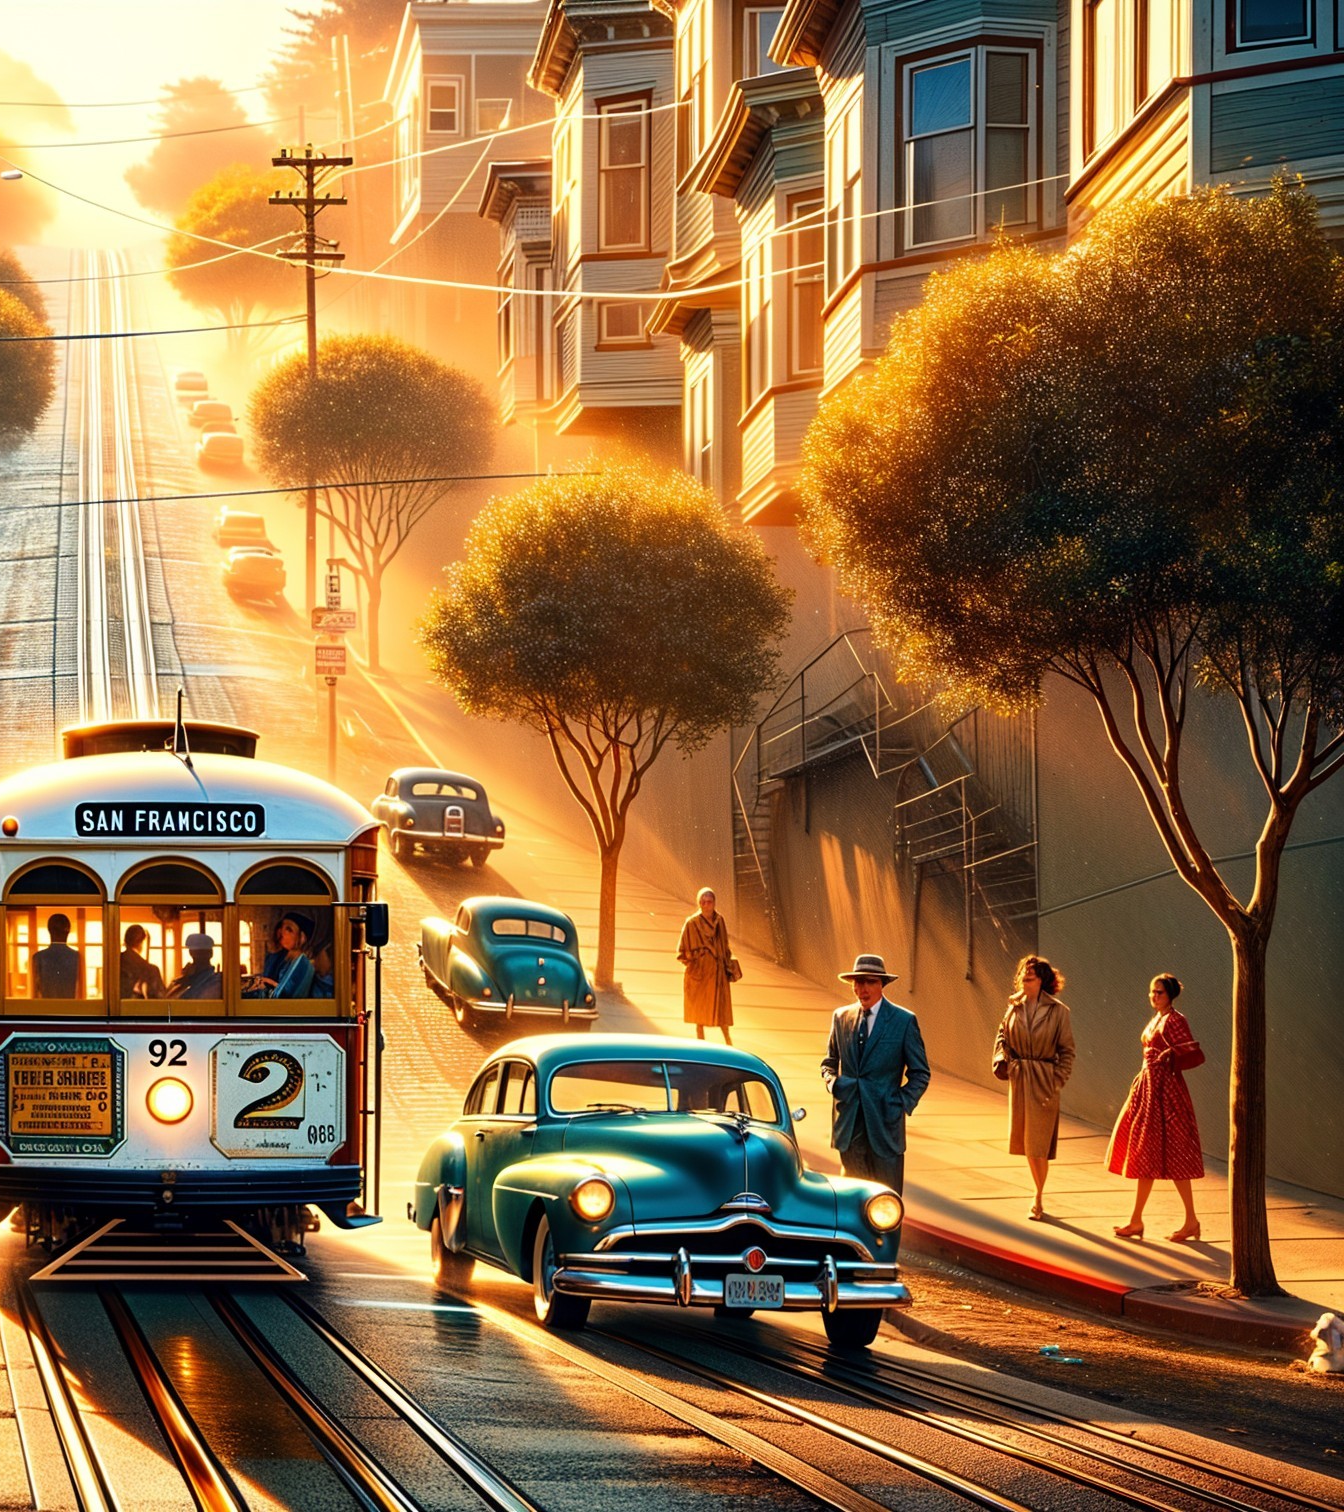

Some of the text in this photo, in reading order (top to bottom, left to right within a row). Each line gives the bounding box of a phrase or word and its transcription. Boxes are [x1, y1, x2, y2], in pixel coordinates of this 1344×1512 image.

[82, 810, 124, 832] SAN
[148, 1039, 188, 1068] 92
[233, 1049, 304, 1130] 2
